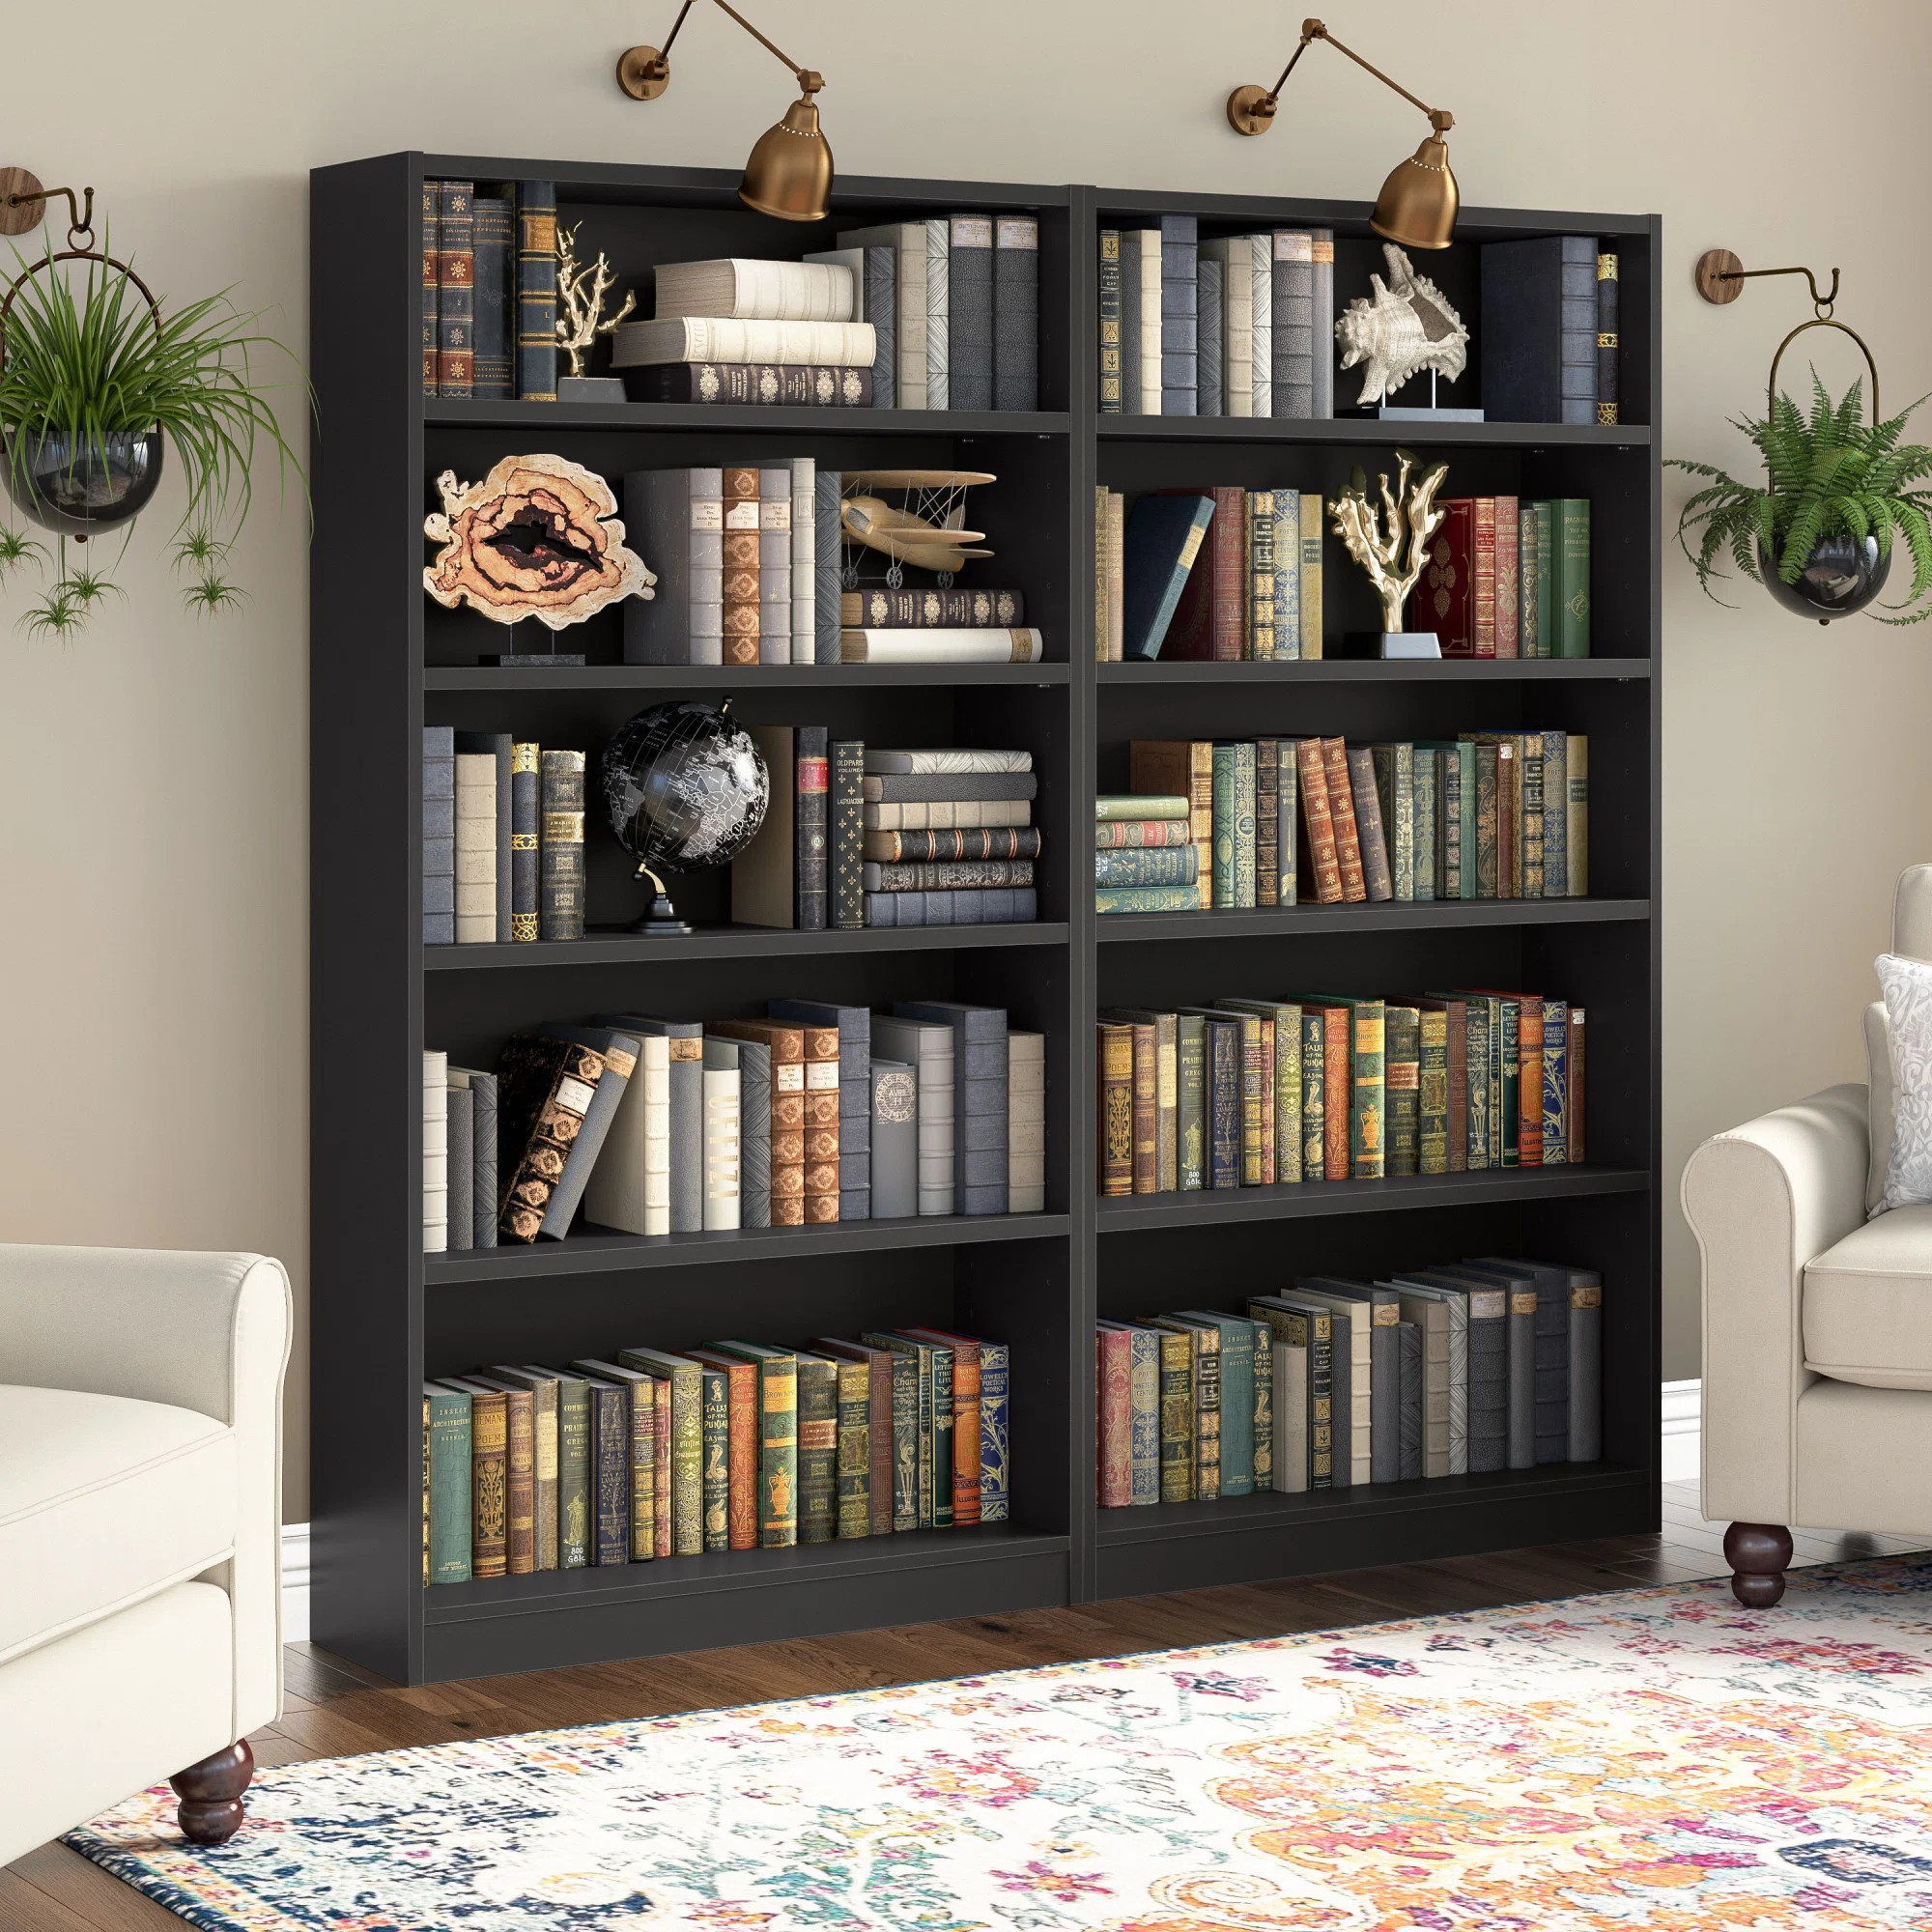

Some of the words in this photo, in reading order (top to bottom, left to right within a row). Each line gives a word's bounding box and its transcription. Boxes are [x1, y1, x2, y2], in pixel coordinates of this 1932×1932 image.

[709, 1094, 738, 1199] UFFIZI
[980, 1372, 1008, 1380] LOWELL'S
[981, 1378, 1007, 1387] POETICAL
[440, 1407, 468, 1416] INSECT
[705, 1404, 727, 1412] TALES
[473, 1414, 506, 1425] HEMANS
[474, 1433, 506, 1444] POEMS
[571, 1547, 583, 1555] 800
